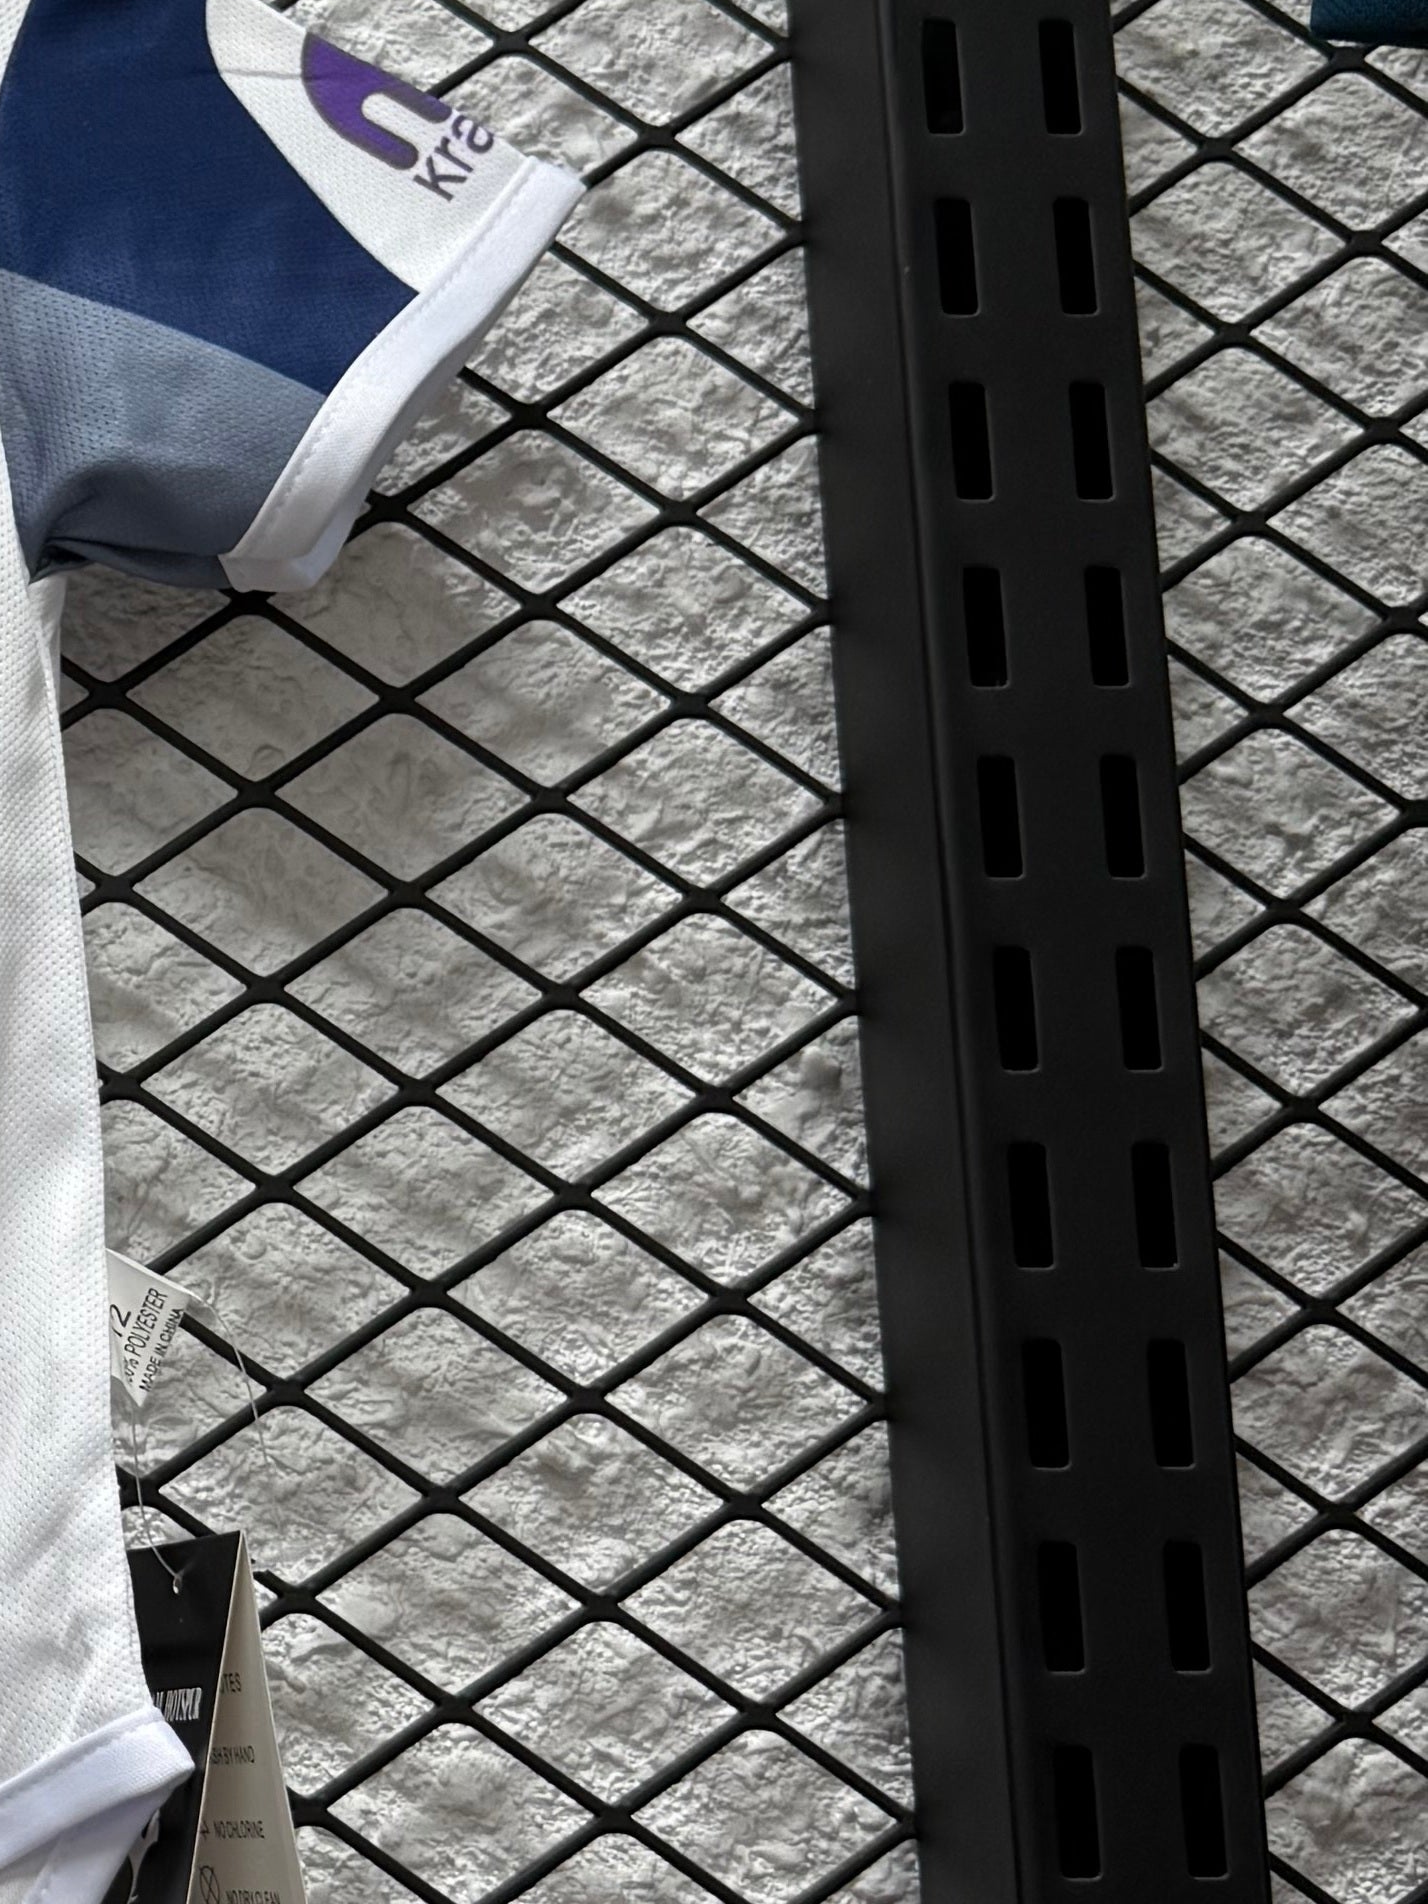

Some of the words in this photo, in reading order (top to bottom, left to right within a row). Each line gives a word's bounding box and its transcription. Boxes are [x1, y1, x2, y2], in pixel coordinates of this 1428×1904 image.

[124, 1287, 168, 1358] POLYESTER
[159, 1307, 184, 1344] CHINA
[154, 1340, 168, 1358] IN
[139, 1355, 162, 1392] MADE
[233, 1745, 255, 1764] HAND
